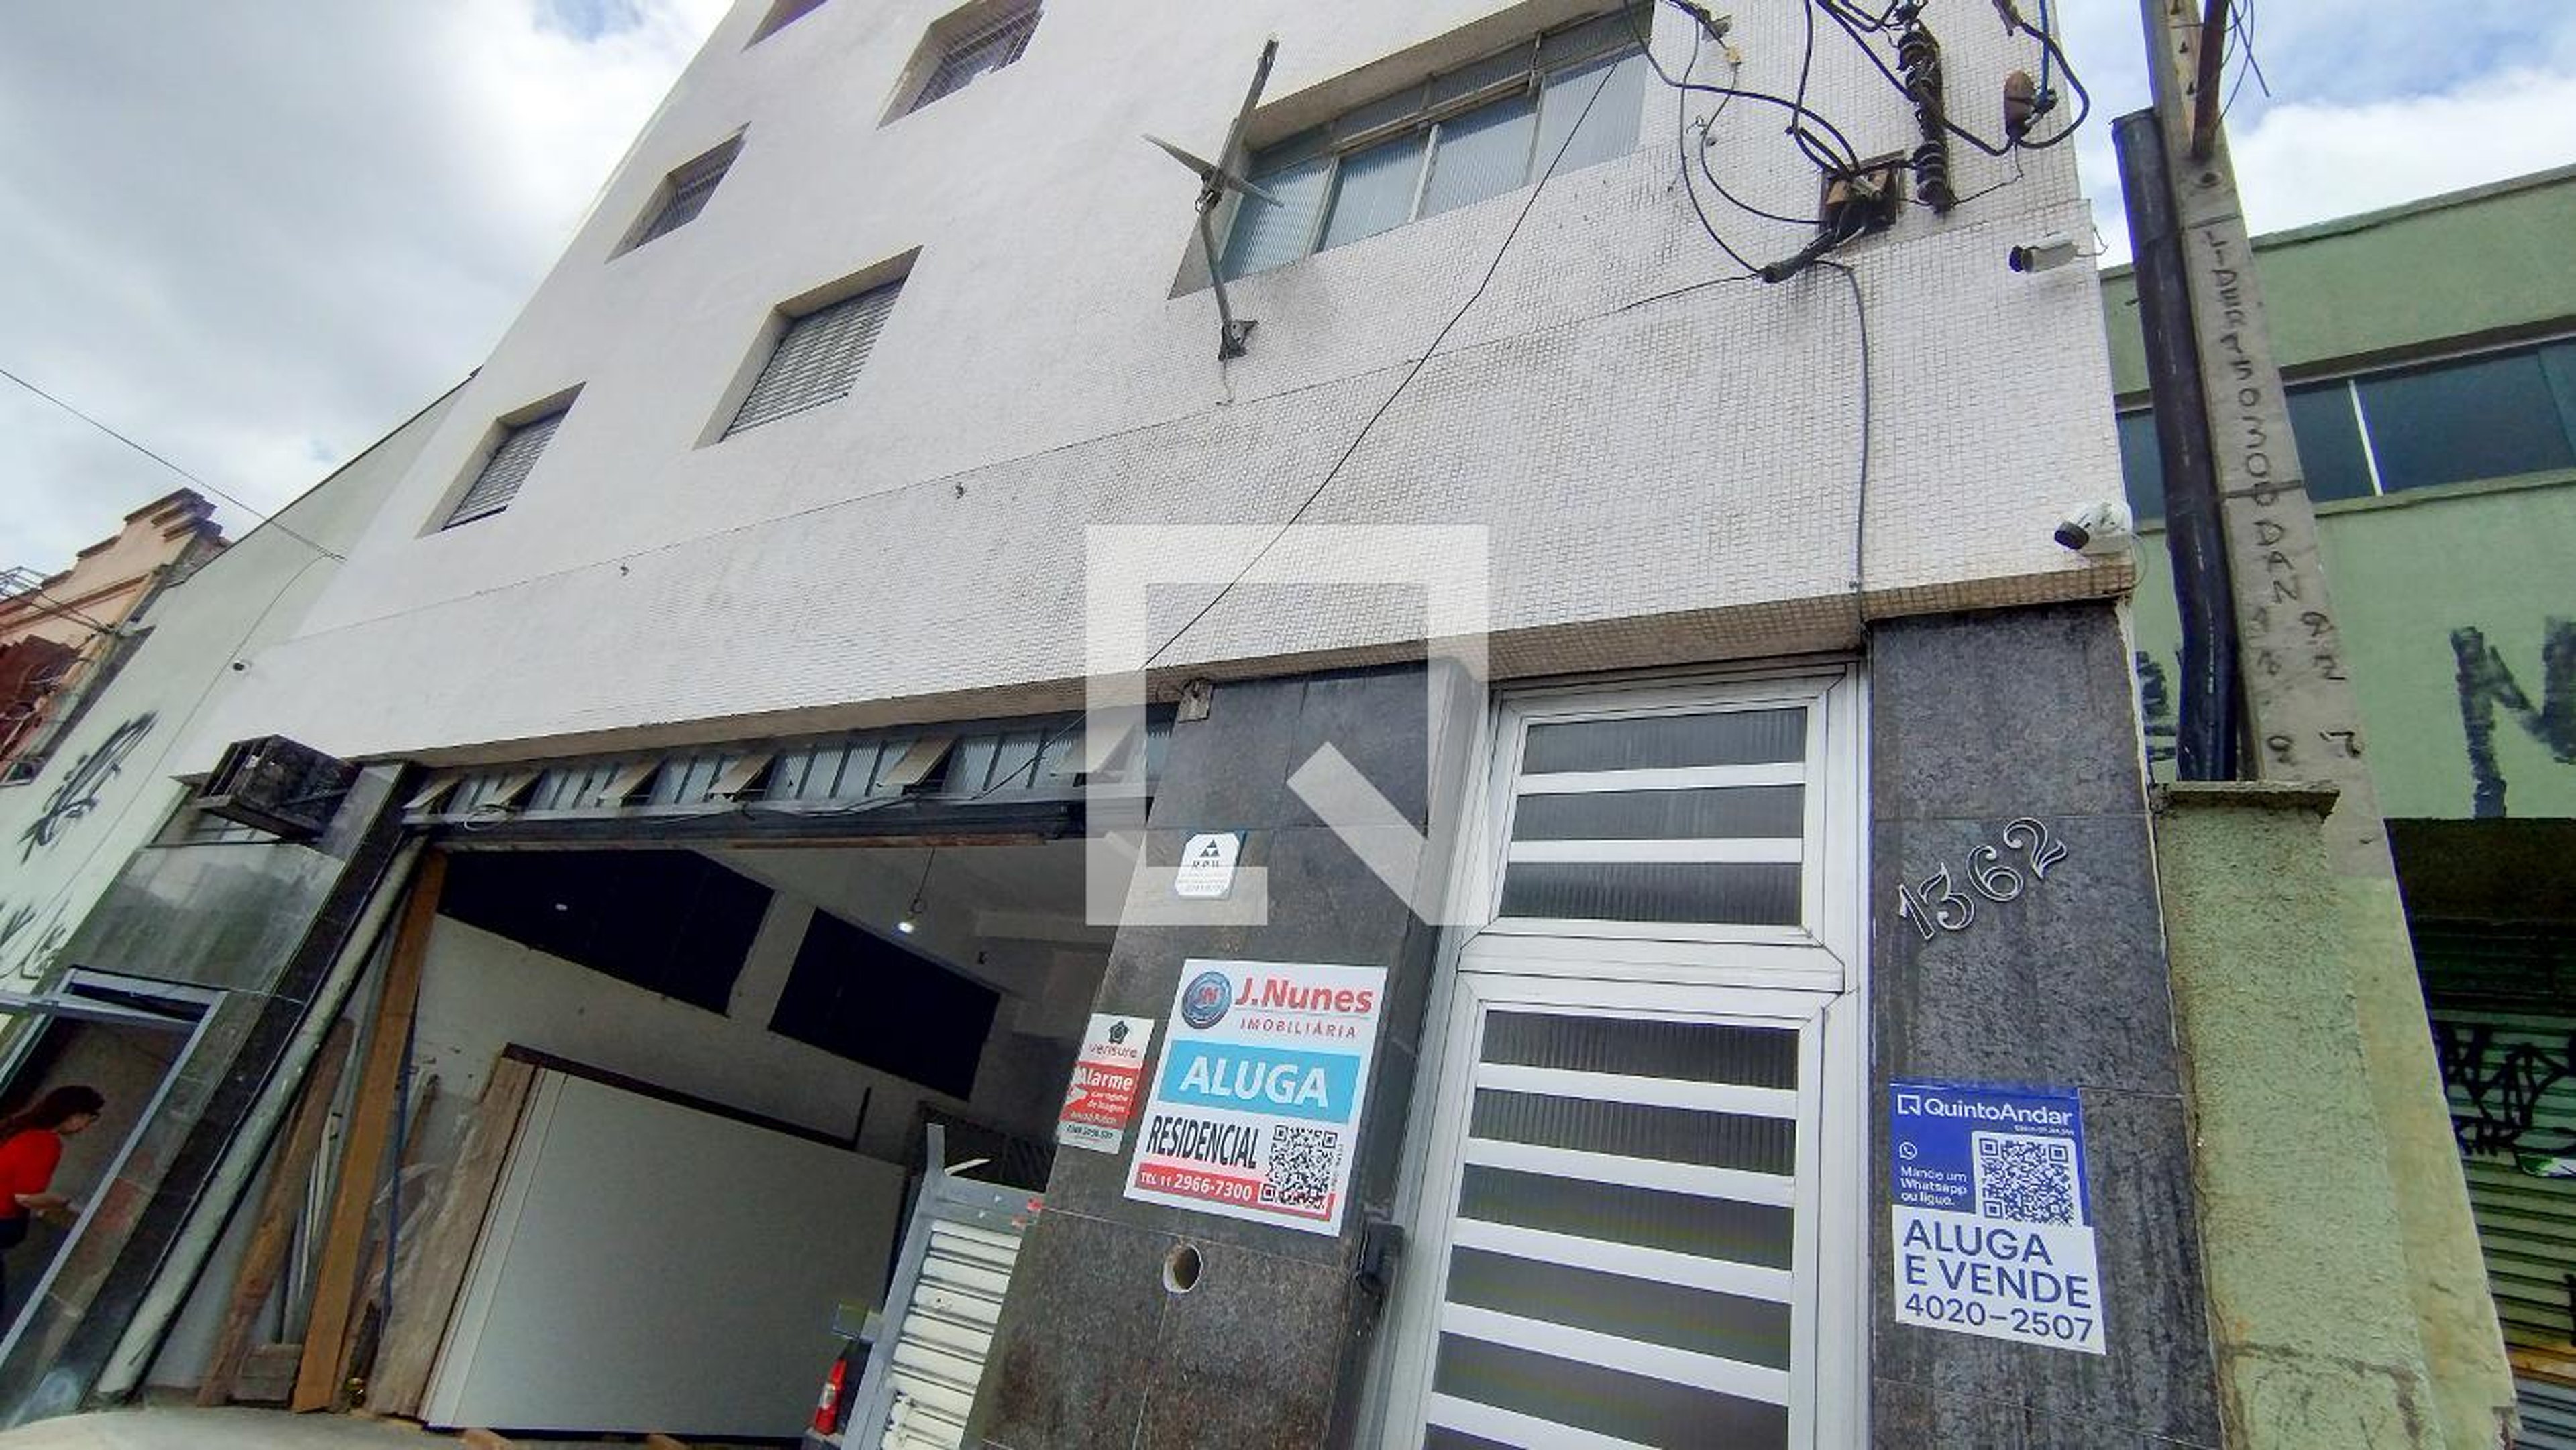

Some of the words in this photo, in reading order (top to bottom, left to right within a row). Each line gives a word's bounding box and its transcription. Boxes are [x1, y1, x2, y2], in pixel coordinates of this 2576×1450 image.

[1899, 817, 2068, 940] 1362
[1235, 977, 1374, 1014] J.Nunes
[1240, 1018, 1356, 1038] IMOBILIÁRIA
[1178, 1056, 1329, 1108] ALUGA
[1924, 1098, 2074, 1125] QuintoAndar
[1145, 1115, 1260, 1169] RESIDENCIAL
[1140, 1172, 1157, 1185] TEL
[1161, 1176, 1171, 1187] 11
[1174, 1174, 1252, 1201] 2966-7300
[1900, 1166, 1944, 1181] Mande
[1946, 1172, 1967, 1182] um
[1900, 1178, 1968, 1196] Whatsapp
[1900, 1192, 1918, 1201] ou
[1903, 1219, 2053, 1266] ALUGA
[1905, 1253, 1927, 1286] E
[1937, 1258, 2092, 1309] VENDE
[1904, 1292, 2094, 1342] 4020-2507
